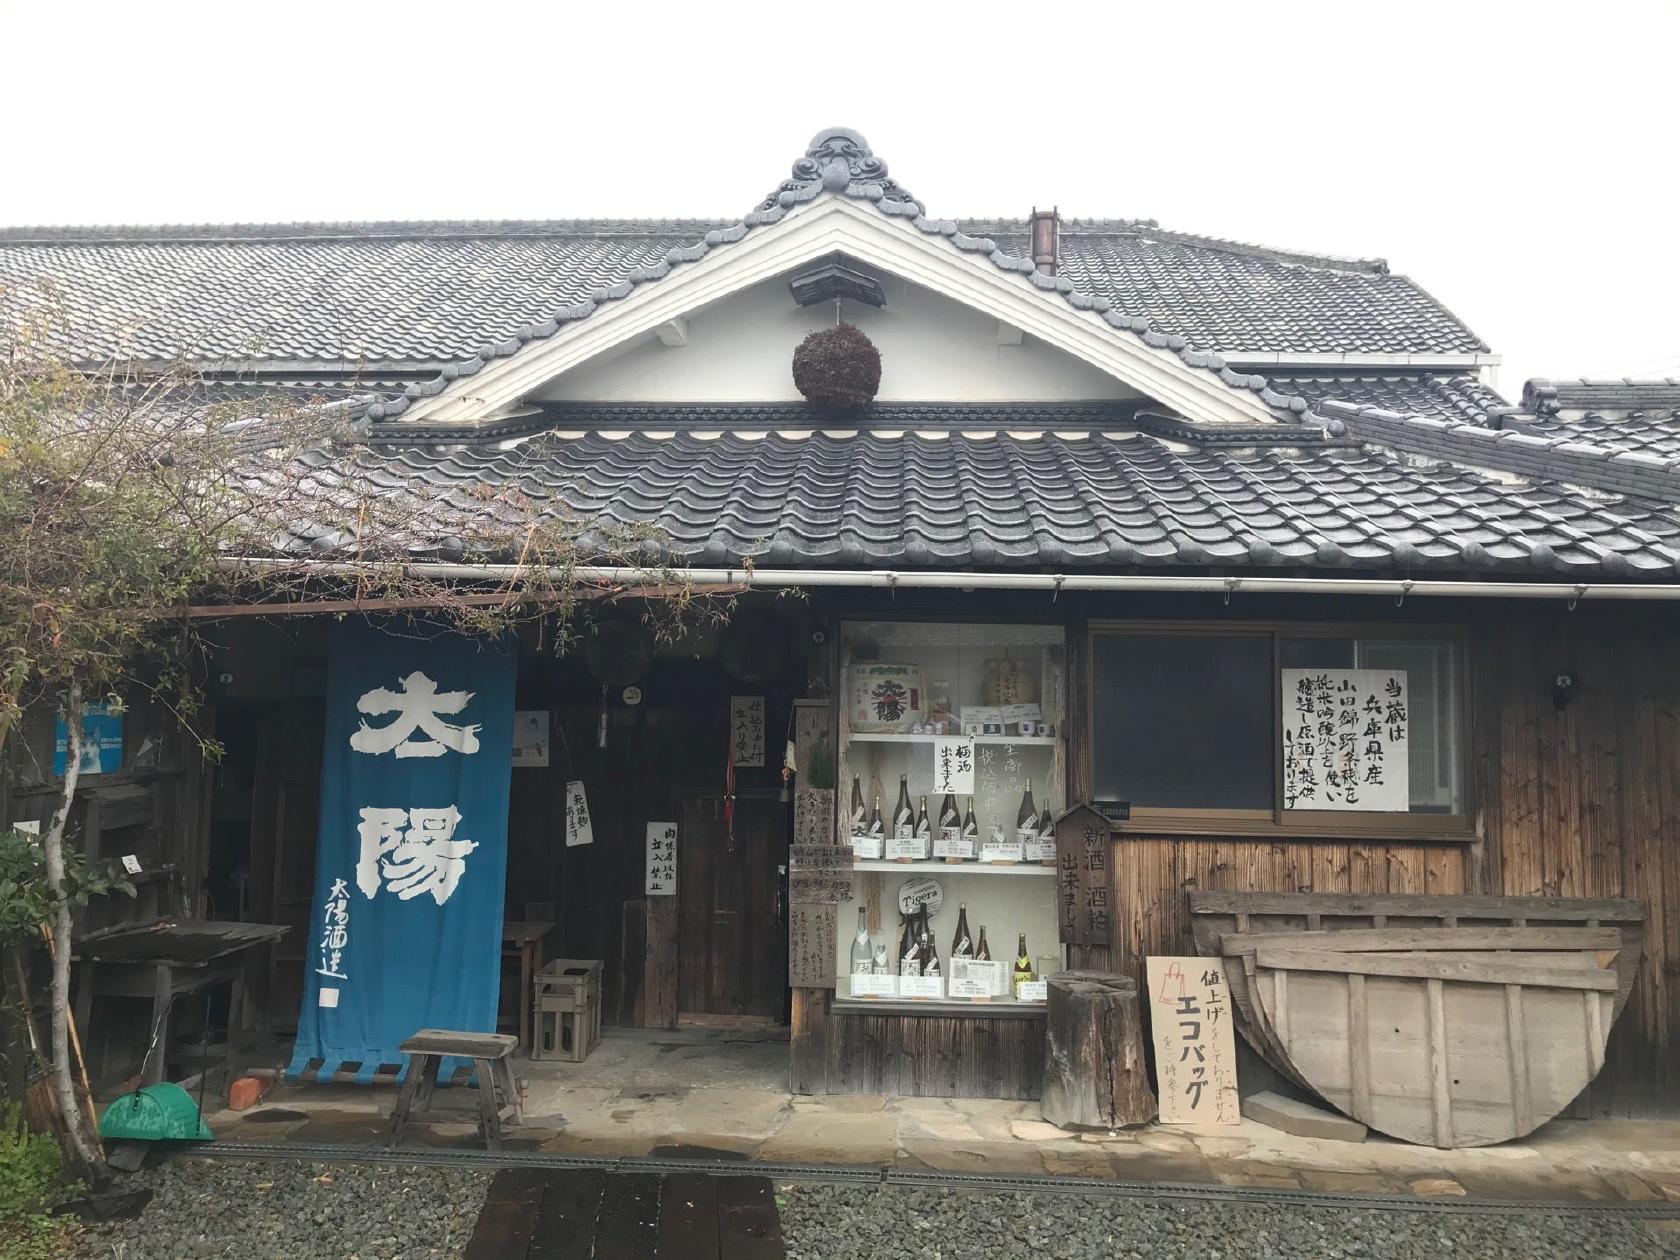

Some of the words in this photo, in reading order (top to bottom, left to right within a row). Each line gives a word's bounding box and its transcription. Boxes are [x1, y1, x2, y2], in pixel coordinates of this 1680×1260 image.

[1363, 694, 1384, 786] 兵庫県産
[1385, 678, 1406, 742] 当蔵は
[350, 671, 482, 906] 太陽
[1285, 729, 1299, 809] しております
[650, 838, 663, 890] 立入禁止
[902, 890, 938, 907] Tigers
[315, 878, 350, 980] 太陽酒造
[1176, 995, 1209, 1110] エコバッグ
